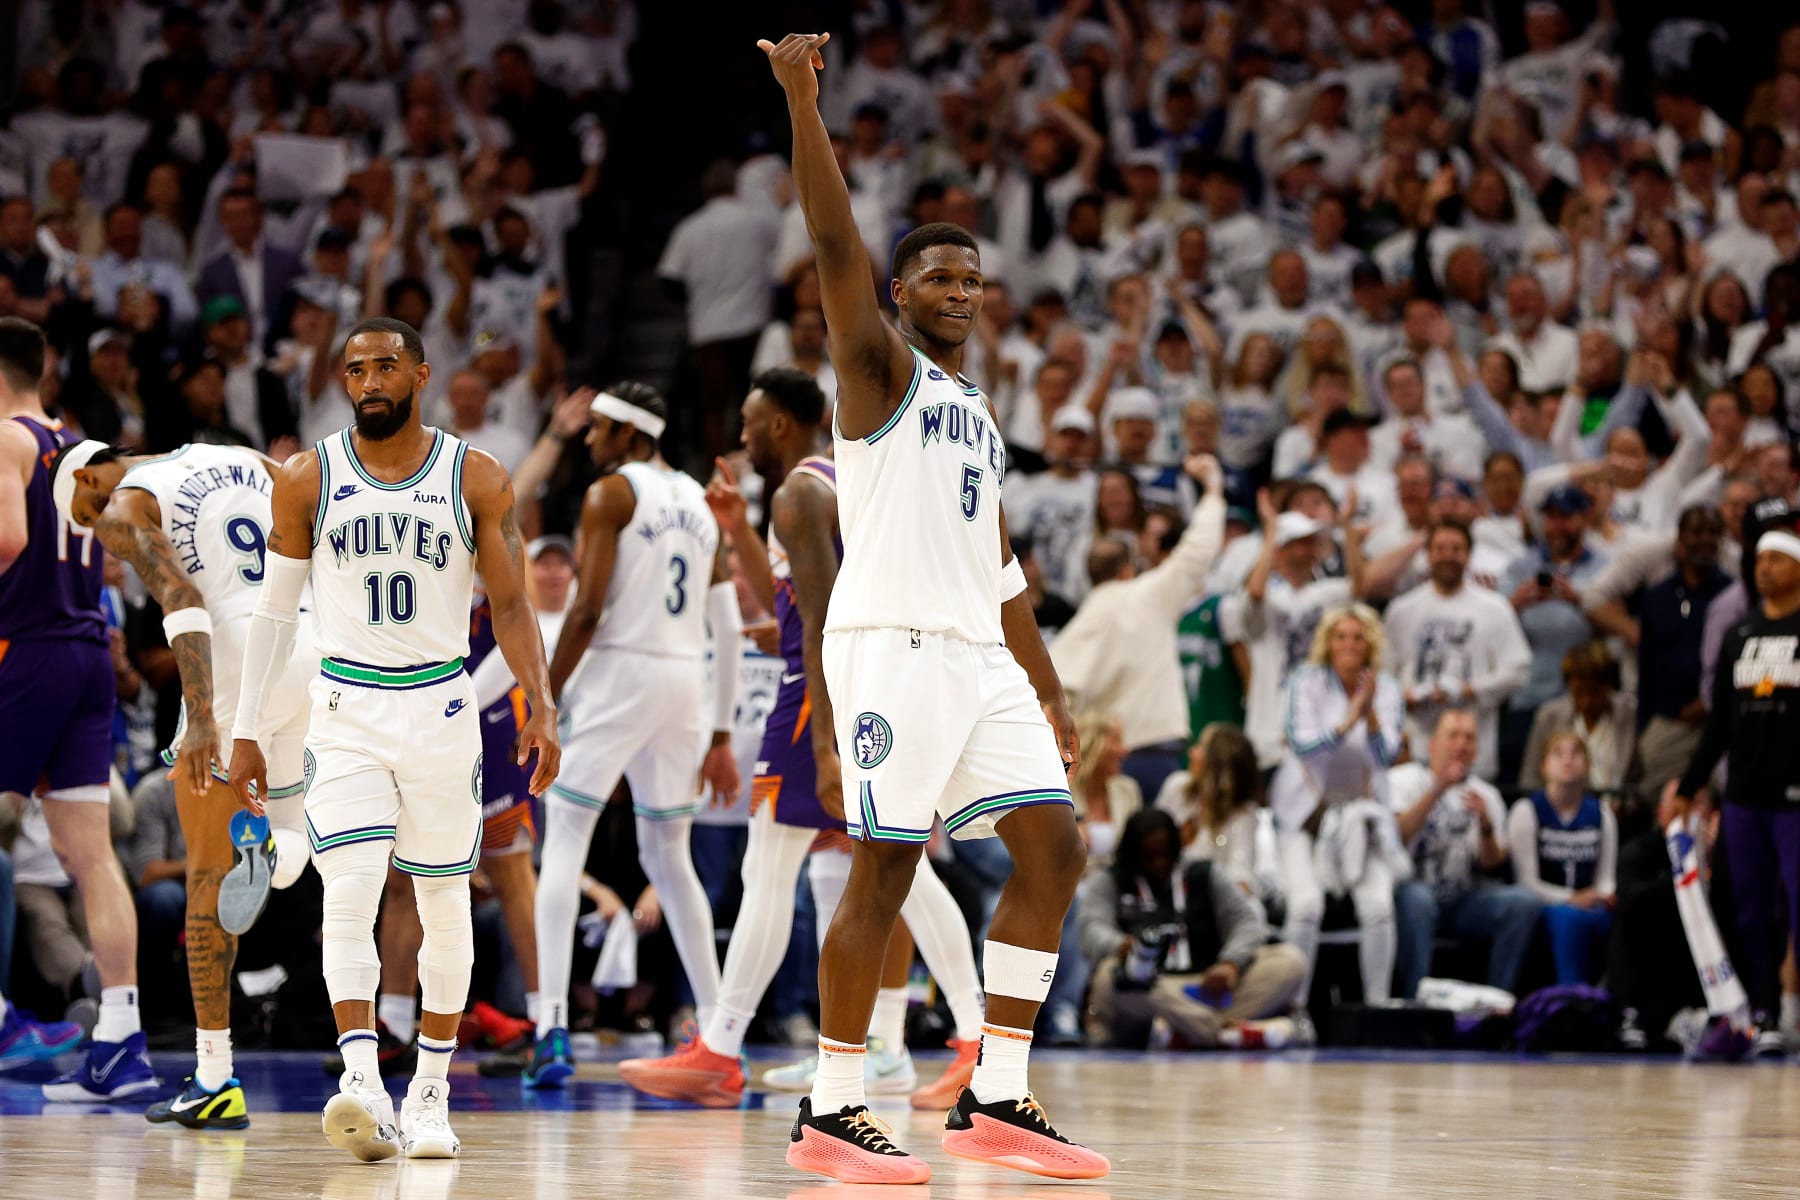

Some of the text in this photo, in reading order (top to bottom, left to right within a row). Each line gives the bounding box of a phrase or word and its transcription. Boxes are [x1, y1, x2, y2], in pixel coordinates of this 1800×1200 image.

[338, 484, 358, 495] NIKE
[960, 462, 984, 522] 5
[223, 512, 267, 587] 9
[326, 512, 453, 572] WOLVES
[364, 570, 417, 625] 10
[665, 553, 690, 618] 3
[448, 698, 464, 710] NIKE
[1040, 969, 1054, 983] 5
